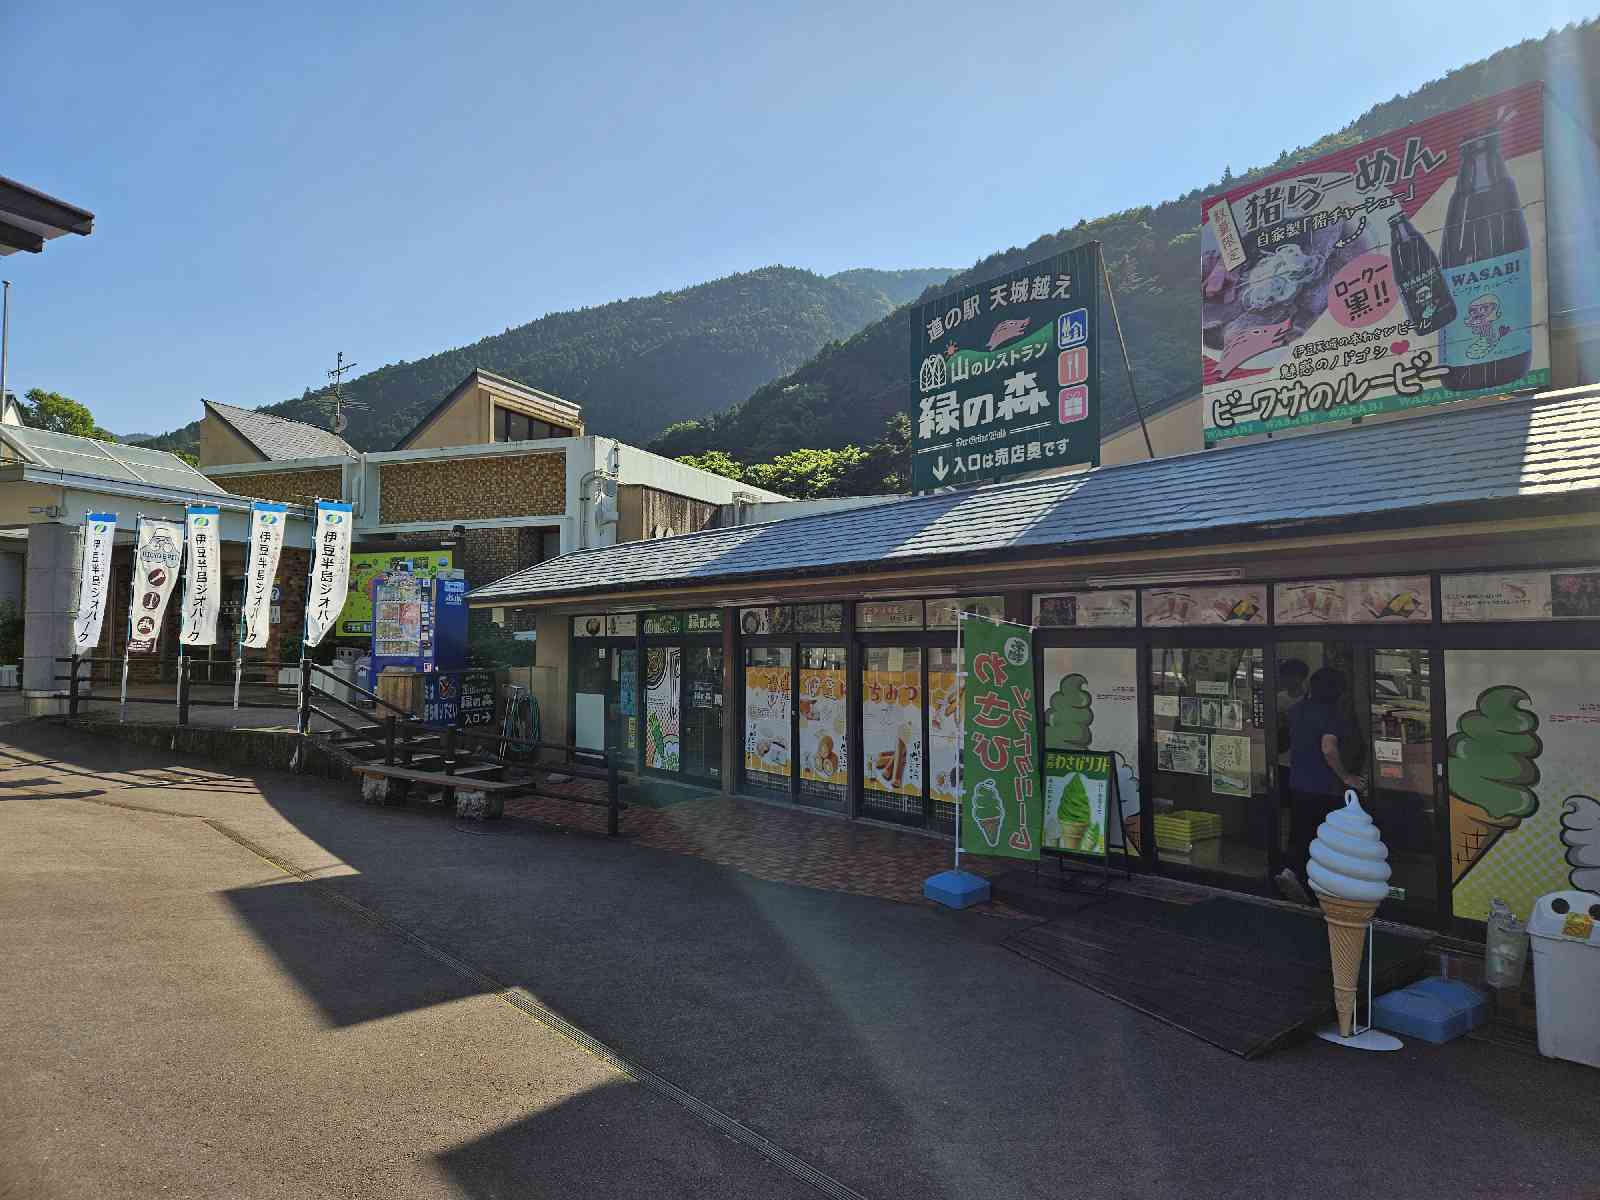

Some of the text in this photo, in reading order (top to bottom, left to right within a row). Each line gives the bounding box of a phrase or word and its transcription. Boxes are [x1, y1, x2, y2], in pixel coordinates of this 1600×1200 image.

[1245, 136, 1447, 233] 猪らーめん
[1256, 183, 1415, 249] 自家製「猪チャーシュー」
[927, 274, 1072, 344] 道の駅 天城越え
[950, 341, 1048, 384] 山のレストラン
[1212, 349, 1451, 428] ビーワサのルービー
[1279, 344, 1388, 381] 魅惑のノドゴシ
[917, 370, 1051, 441] 緑の森
[953, 438, 1070, 475] 入口は売店奥です
[187, 533, 208, 642] 伊豆半島ジオパーク
[248, 530, 272, 643] 伊豆半島ジオパーク
[464, 712, 481, 728] 入口
